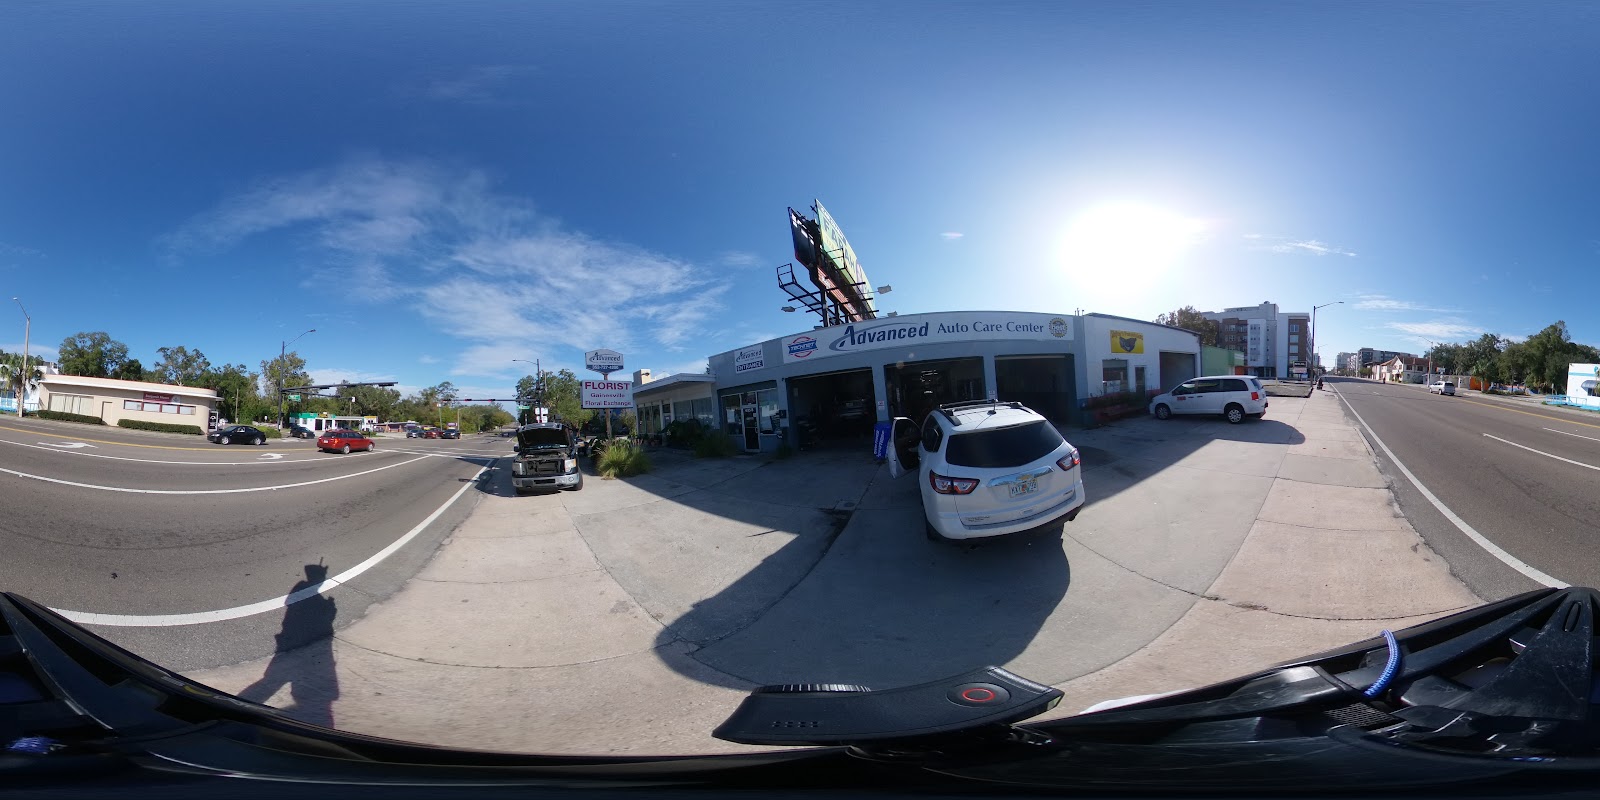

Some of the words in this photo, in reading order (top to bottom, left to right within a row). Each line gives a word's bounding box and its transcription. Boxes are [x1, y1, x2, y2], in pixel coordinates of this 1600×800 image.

[838, 322, 929, 348] Advanced
[937, 322, 969, 334] Auto
[973, 321, 1003, 333] Care
[1006, 321, 1044, 333] Center
[592, 352, 621, 362] Advanced
[736, 361, 763, 372] ENTRANCE
[584, 381, 630, 390] FLORIST
